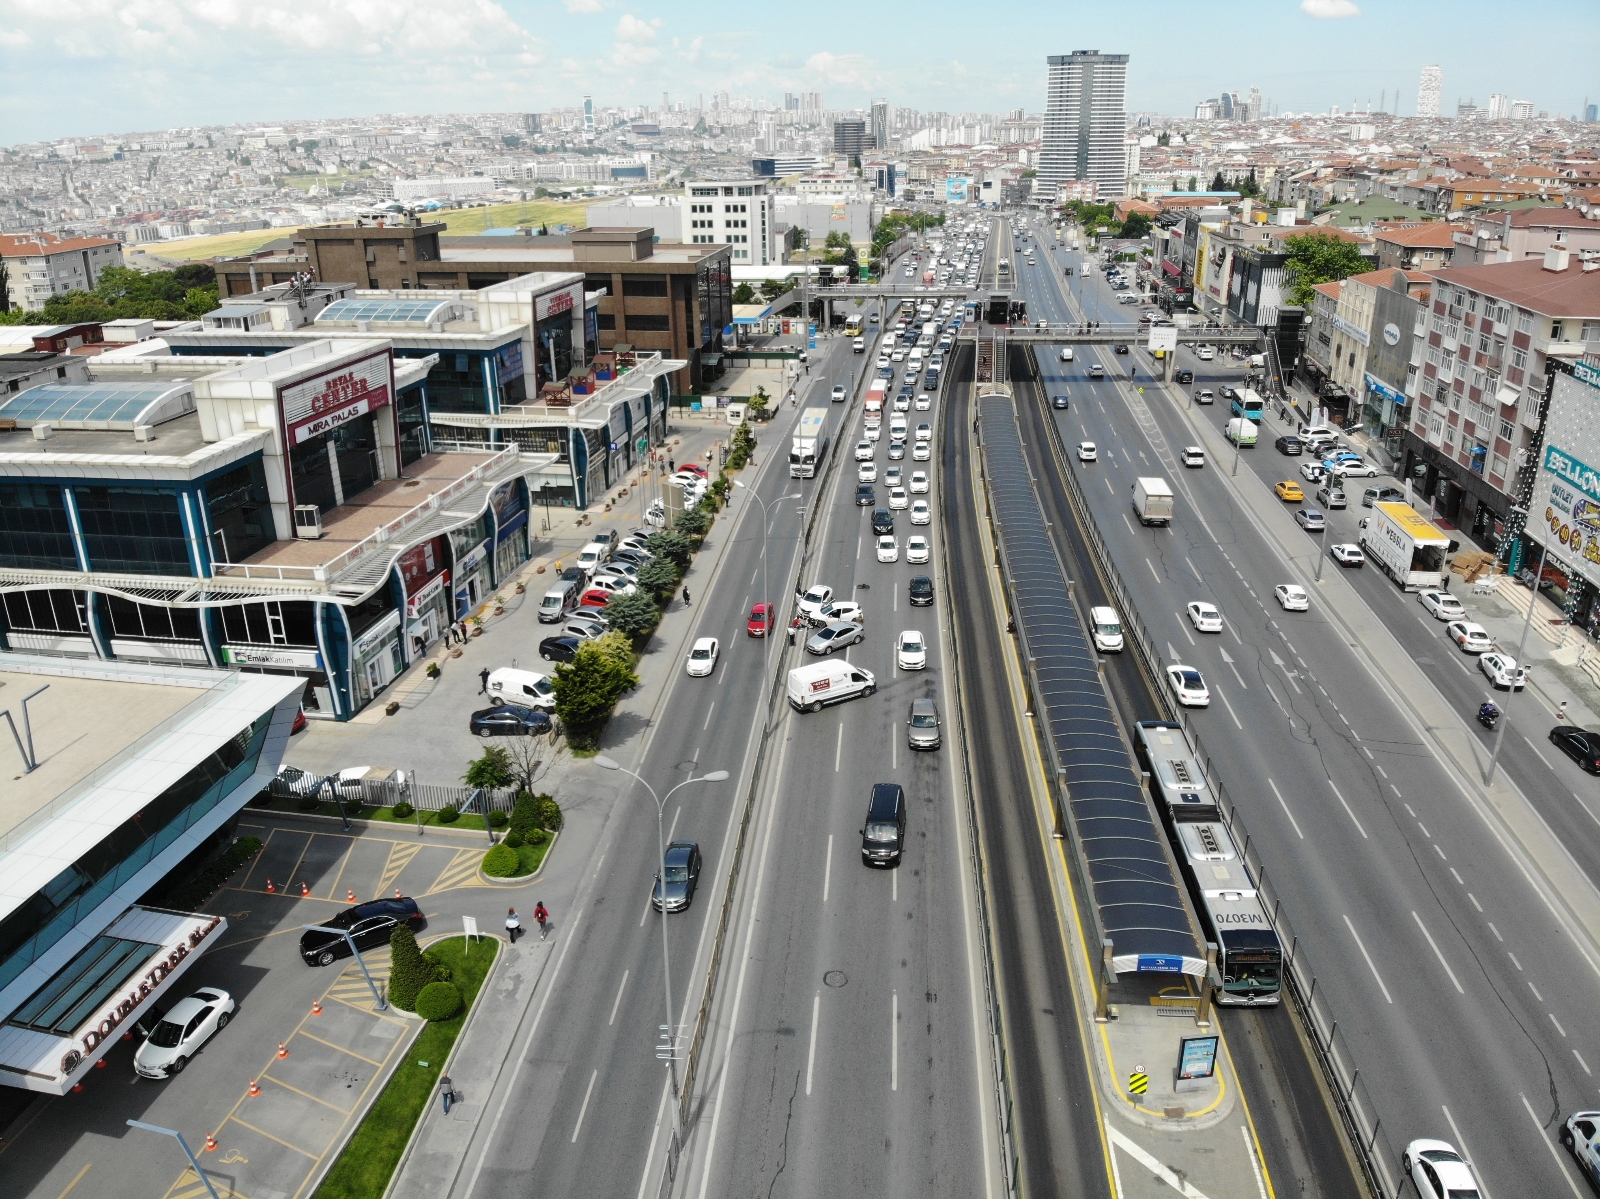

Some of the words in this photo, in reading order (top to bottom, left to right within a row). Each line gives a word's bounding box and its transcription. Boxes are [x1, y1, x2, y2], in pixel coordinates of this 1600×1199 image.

[1574, 364, 1600, 386] BELL
[311, 378, 369, 412] CENTER
[331, 406, 359, 424] PALAS
[1552, 482, 1573, 505] OUTLET
[1216, 914, 1263, 923] M3070
